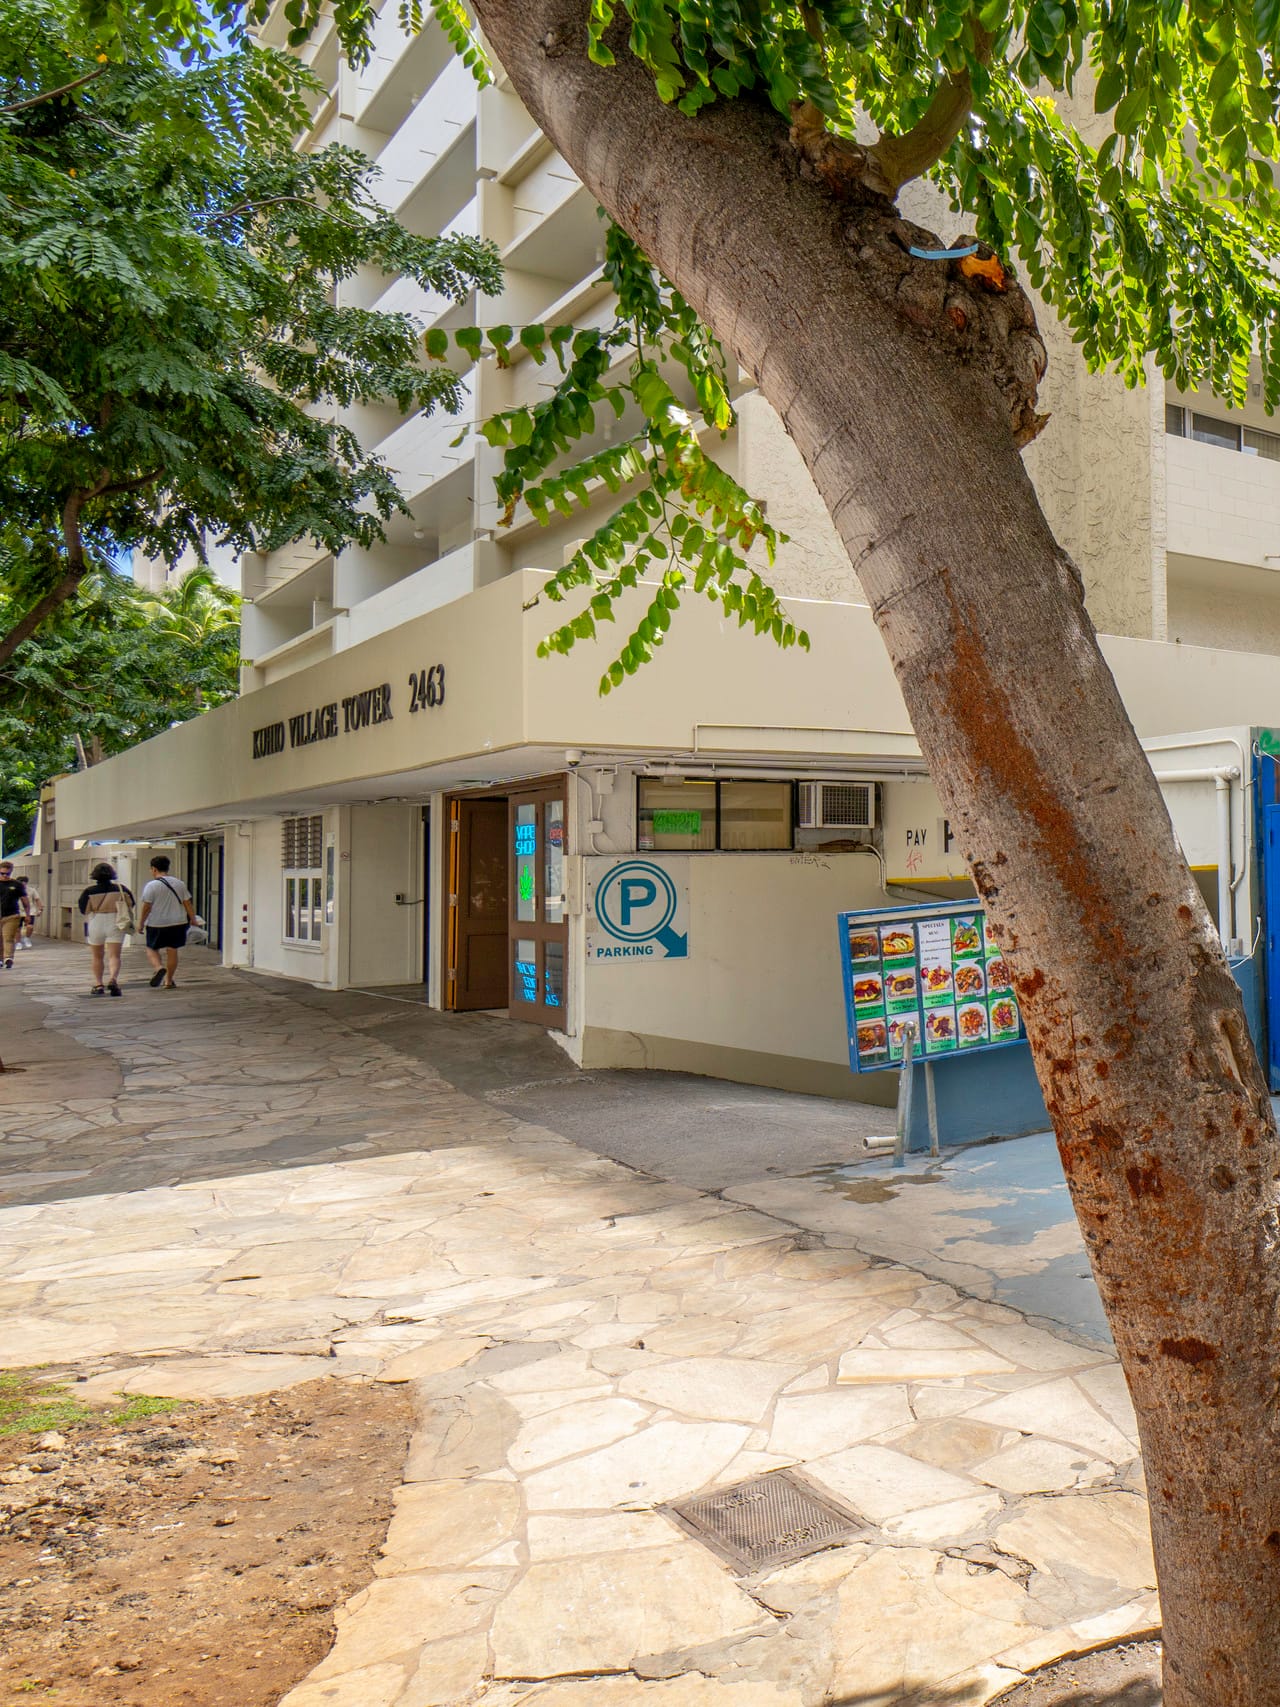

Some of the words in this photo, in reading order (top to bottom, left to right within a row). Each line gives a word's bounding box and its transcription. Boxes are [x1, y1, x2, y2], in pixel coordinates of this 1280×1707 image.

[253, 721, 285, 759] KUHIO
[288, 703, 338, 748] VILLAGE
[342, 683, 393, 732] TOWER
[409, 664, 445, 712] 2463
[516, 824, 536, 839] VAPE
[906, 829, 926, 847] PAY
[621, 879, 656, 925] P
[597, 945, 653, 958] PARKING
